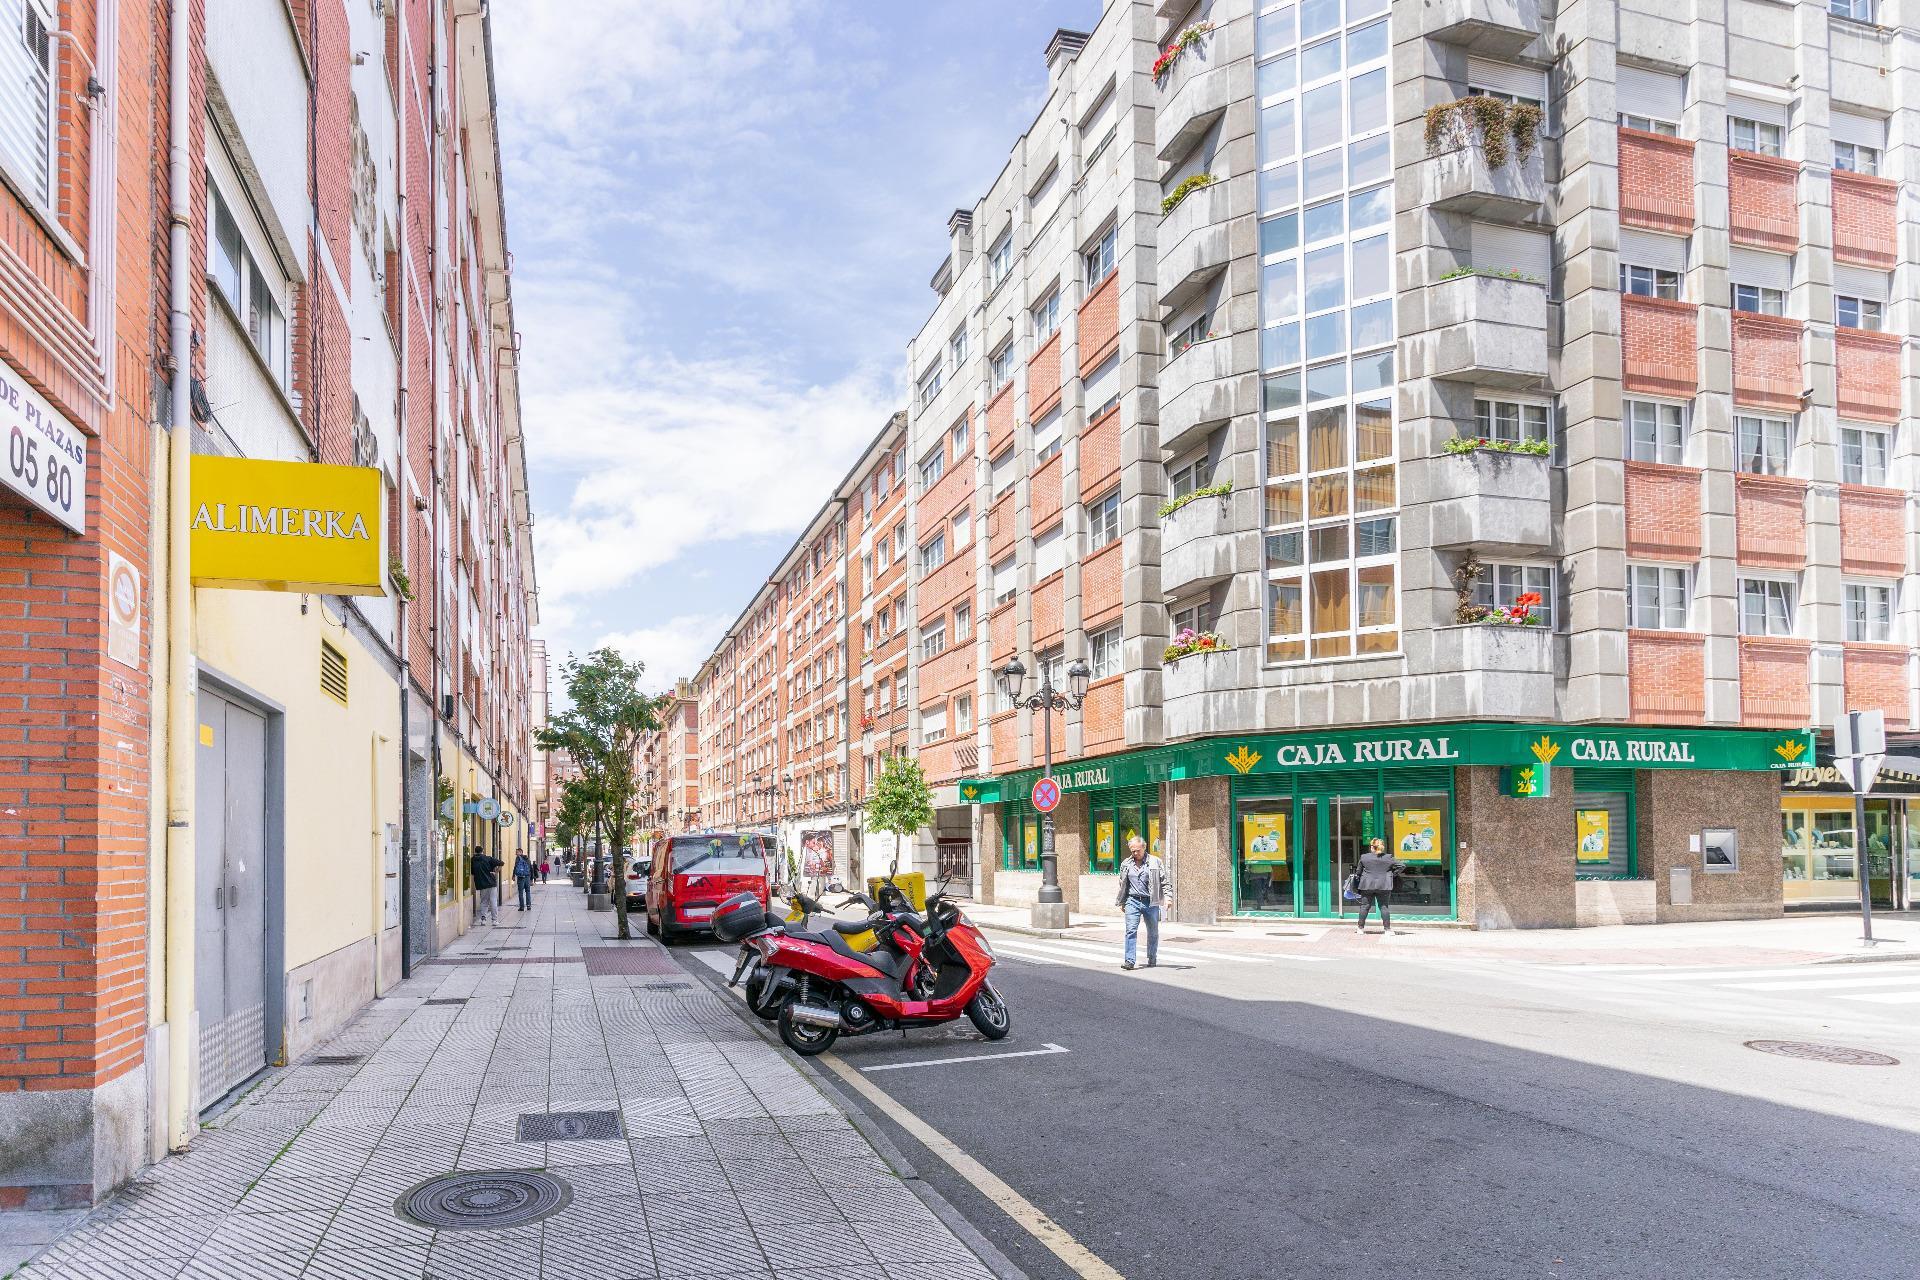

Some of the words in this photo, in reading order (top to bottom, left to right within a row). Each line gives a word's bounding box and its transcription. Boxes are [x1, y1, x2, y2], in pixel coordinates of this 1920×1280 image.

[26, 400, 83, 465] PLAZAS
[10, 425, 39, 489] 05
[46, 454, 72, 513] 80
[190, 502, 370, 540] ALIMERKA
[1277, 743, 1346, 766] CAJA
[1353, 737, 1459, 762] RURAL
[1571, 738, 1622, 762] CAJA
[1626, 740, 1695, 763] RURAL
[1074, 767, 1110, 788] RURAL
[1517, 783, 1537, 795] 24h
